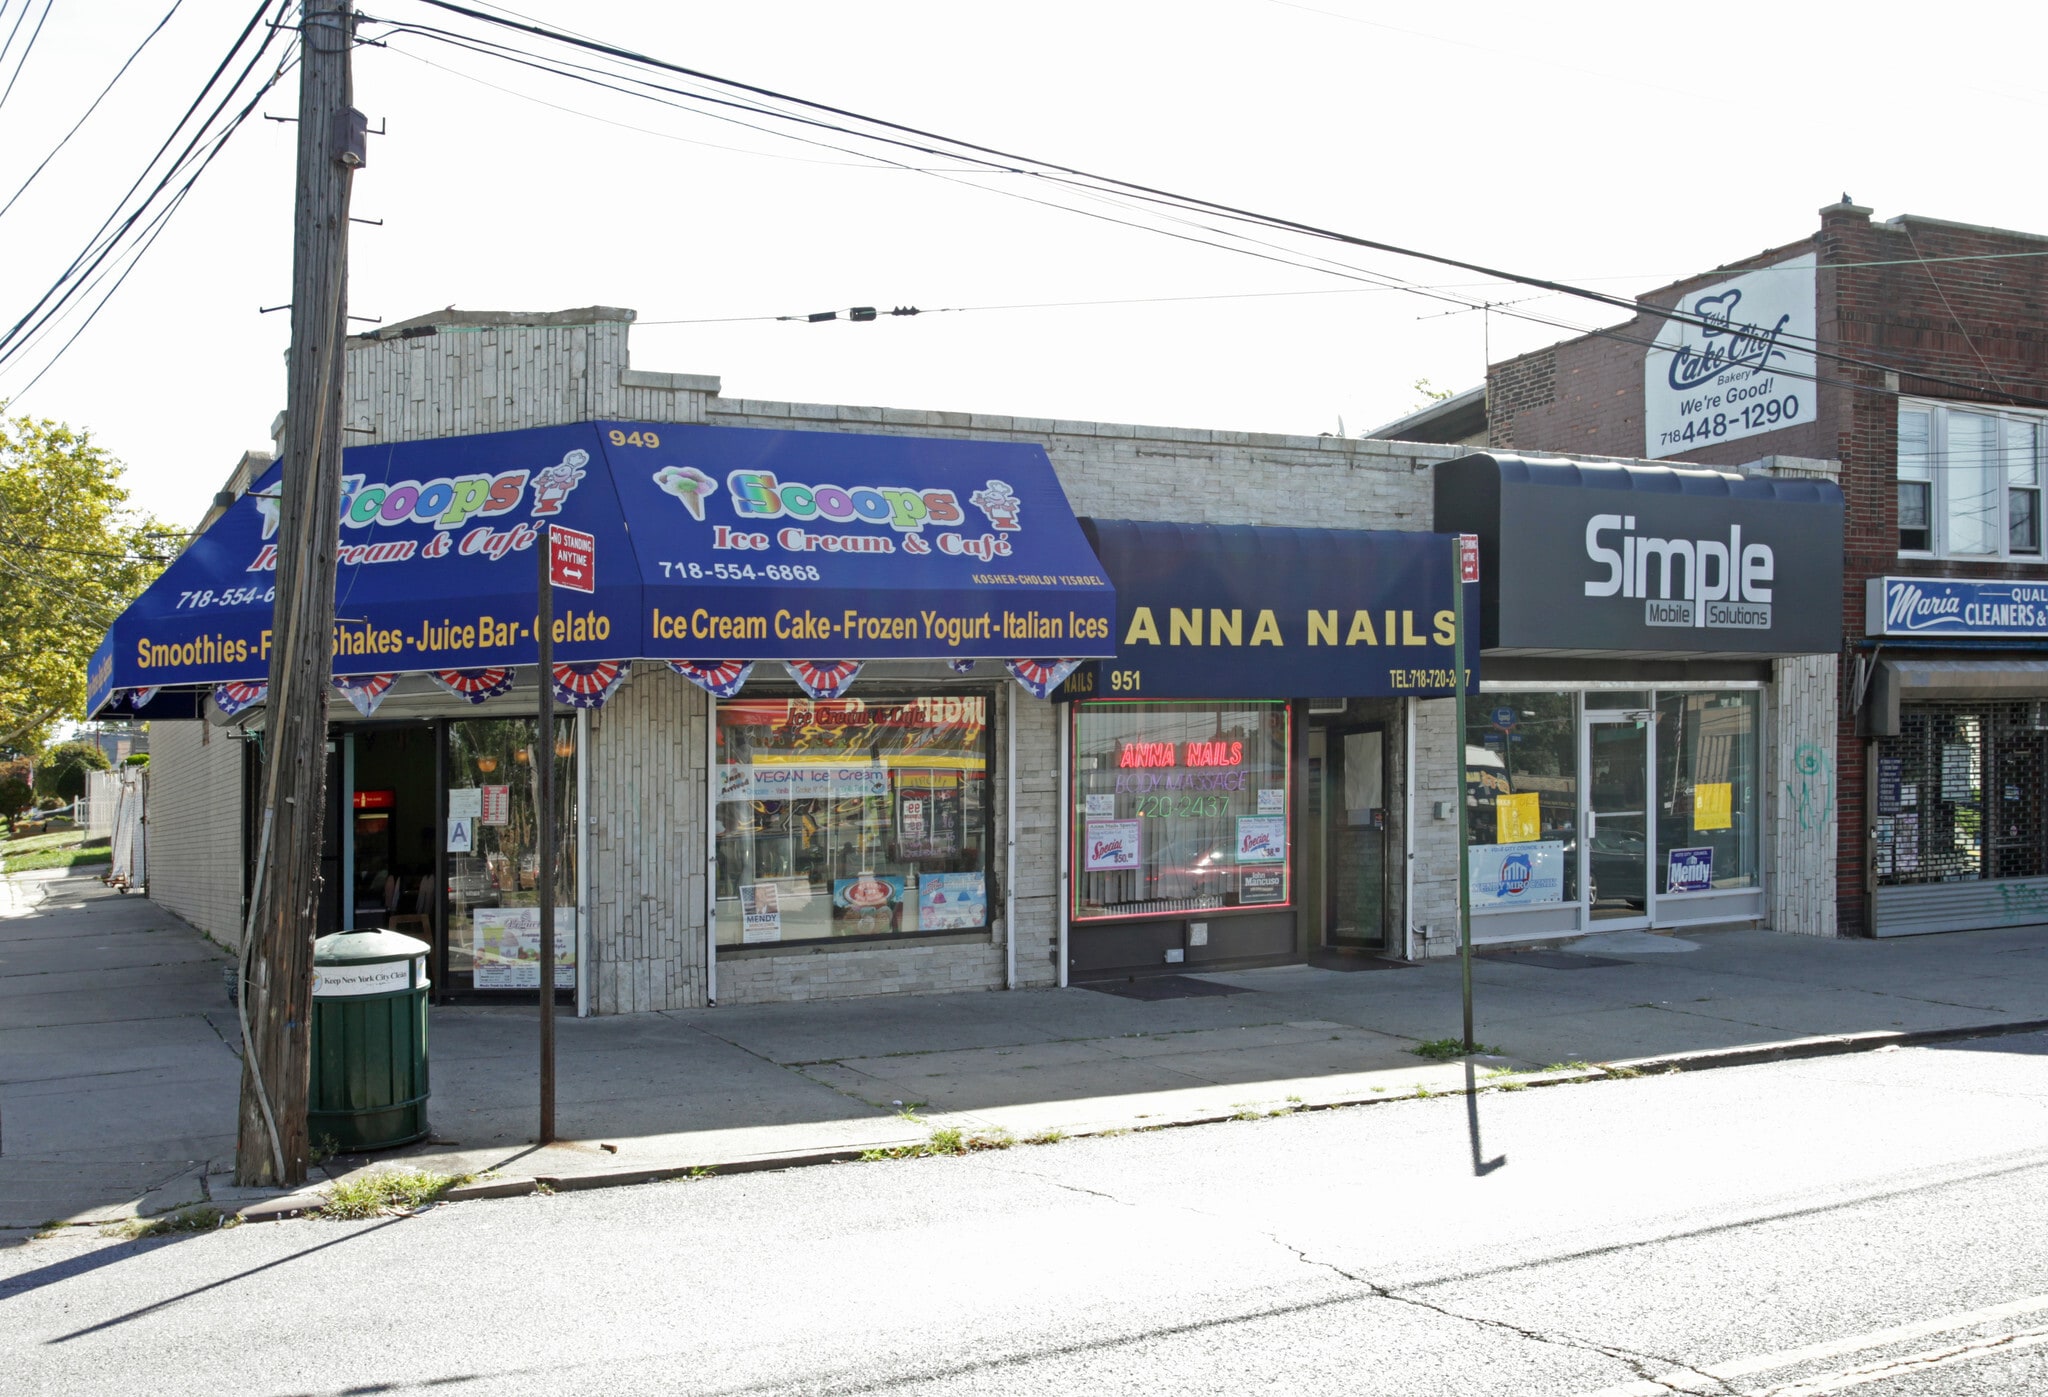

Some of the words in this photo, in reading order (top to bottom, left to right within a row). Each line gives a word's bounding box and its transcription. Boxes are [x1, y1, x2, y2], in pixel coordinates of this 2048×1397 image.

[1668, 341, 1726, 391] Cake
[1727, 314, 1790, 376] Chef
[1717, 371, 1752, 386] Bakery
[1680, 395, 1721, 416] We're
[1726, 377, 1774, 404] Good!
[608, 429, 660, 449] 949
[730, 473, 961, 529] Scoops
[336, 541, 416, 565] ream
[422, 532, 452, 558] &
[459, 520, 545, 561] Café
[552, 531, 562, 545] NO
[563, 534, 592, 553] STANDING
[713, 527, 769, 550] Ice
[777, 529, 893, 553] Cream
[903, 532, 930, 555] &
[939, 532, 1013, 562] Café
[557, 549, 588, 567] ANYTIME
[659, 562, 821, 582] 718-554-6868
[1059, 575, 1105, 587] YISROEL
[1584, 513, 1775, 628] Simple
[1649, 604, 1691, 624] Mobile
[1709, 605, 1768, 626] Solutions
[1889, 583, 1963, 629] Maria
[1965, 603, 2035, 627] CLEANERS
[2036, 610, 2047, 627] &
[653, 608, 687, 639] Ice
[691, 608, 767, 639] Cream
[1069, 611, 1109, 639] Ices
[1124, 606, 1284, 647] ANNA
[1307, 609, 1456, 647] NAILS
[1063, 672, 1093, 694] NAILS
[1111, 670, 1141, 691] 951
[1389, 668, 1471, 689] TEL:718-720-27
[1120, 742, 1175, 768] ANNA
[1185, 741, 1243, 767] NAILS
[754, 770, 804, 784] VEGAN
[811, 770, 830, 782] Ice
[838, 769, 884, 781] Cream
[1115, 771, 1162, 794] BODY
[1165, 769, 1249, 791] MASSAGE
[451, 822, 468, 843] A
[1241, 832, 1270, 854] Special
[1092, 839, 1123, 861] Special
[1245, 877, 1280, 887] Mancuso
[1252, 871, 1266, 880] John
[1671, 860, 1710, 883] Mendy
[746, 914, 777, 924] MENDY
[324, 977, 342, 986] Keep
[342, 976, 357, 984] New
[357, 975, 375, 983] York
[375, 973, 390, 983] City
[390, 971, 407, 980] Clean
